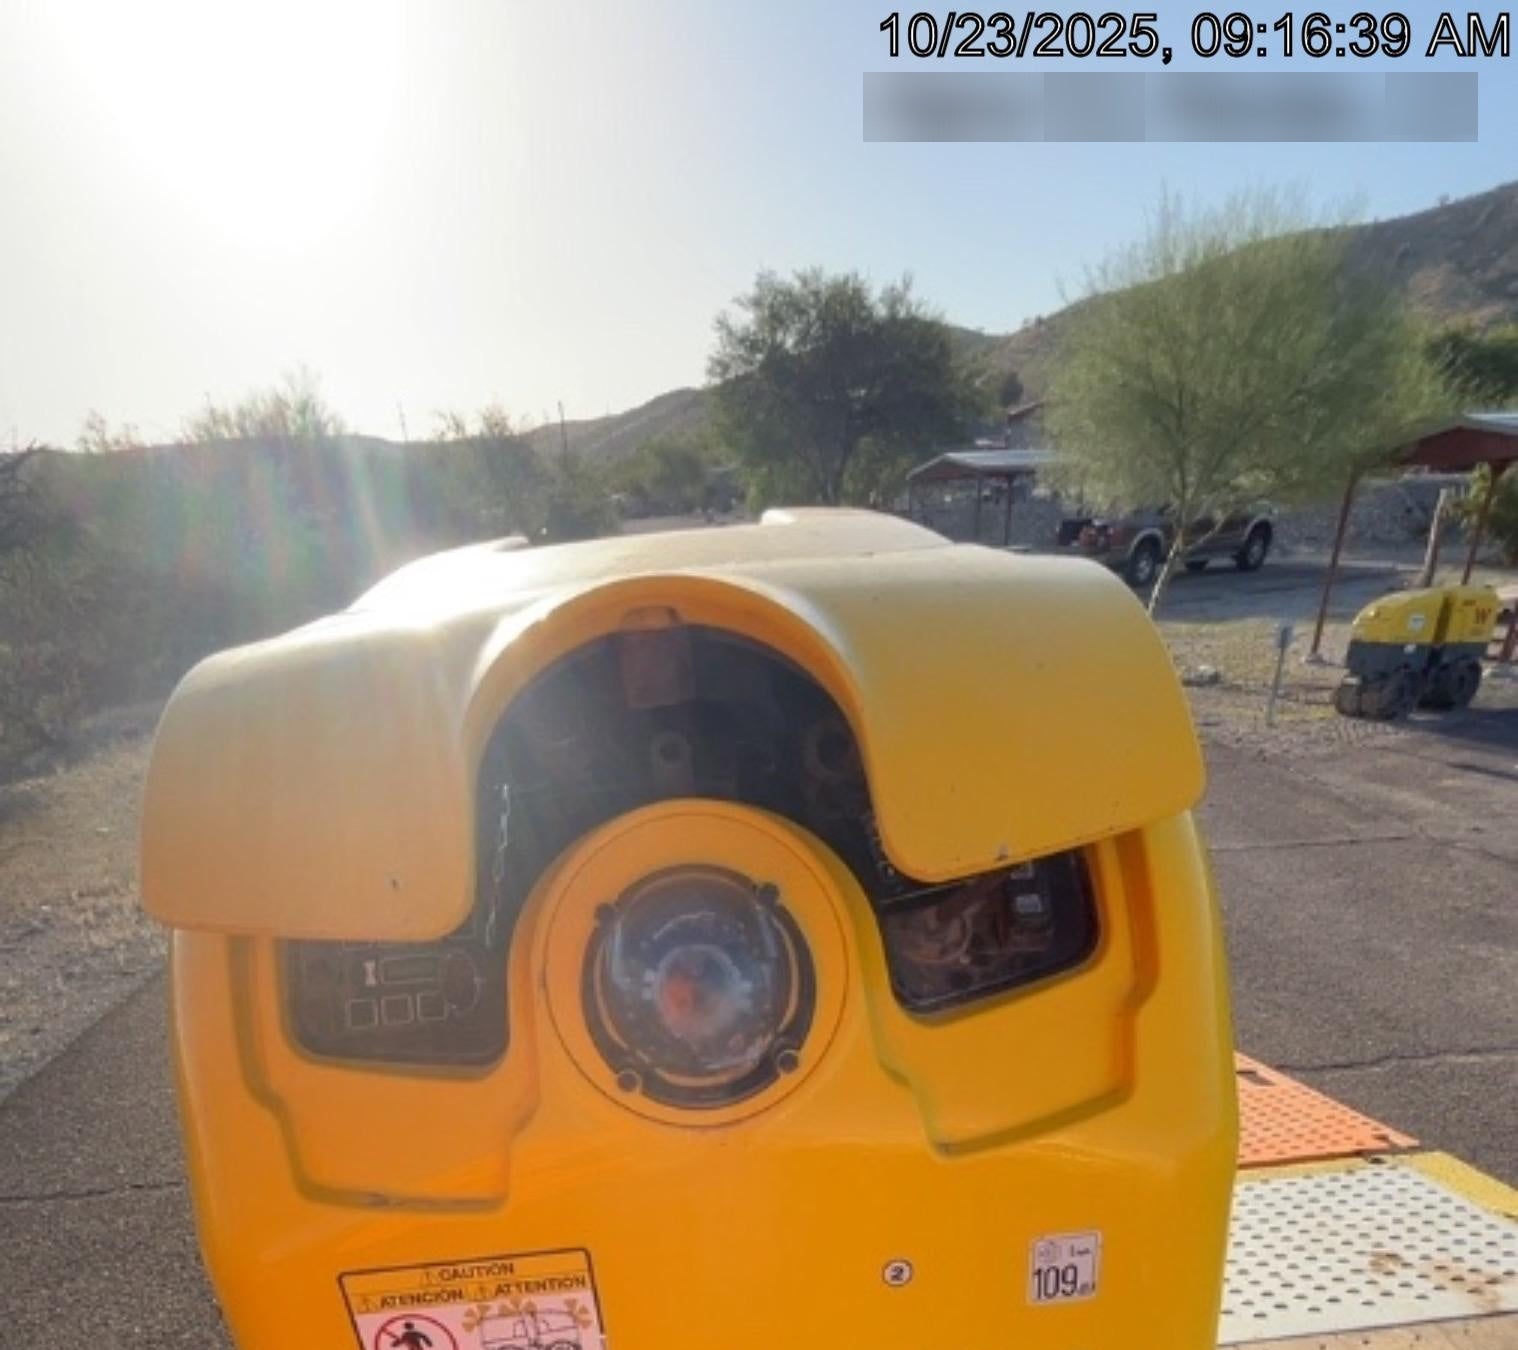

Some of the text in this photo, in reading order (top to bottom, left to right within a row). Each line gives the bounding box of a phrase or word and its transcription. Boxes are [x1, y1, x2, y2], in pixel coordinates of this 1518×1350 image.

[437, 1262, 515, 1282] CAUTION
[890, 1265, 904, 1281] 2
[1033, 1263, 1078, 1299] 109
[494, 1275, 586, 1297] ATTENTION
